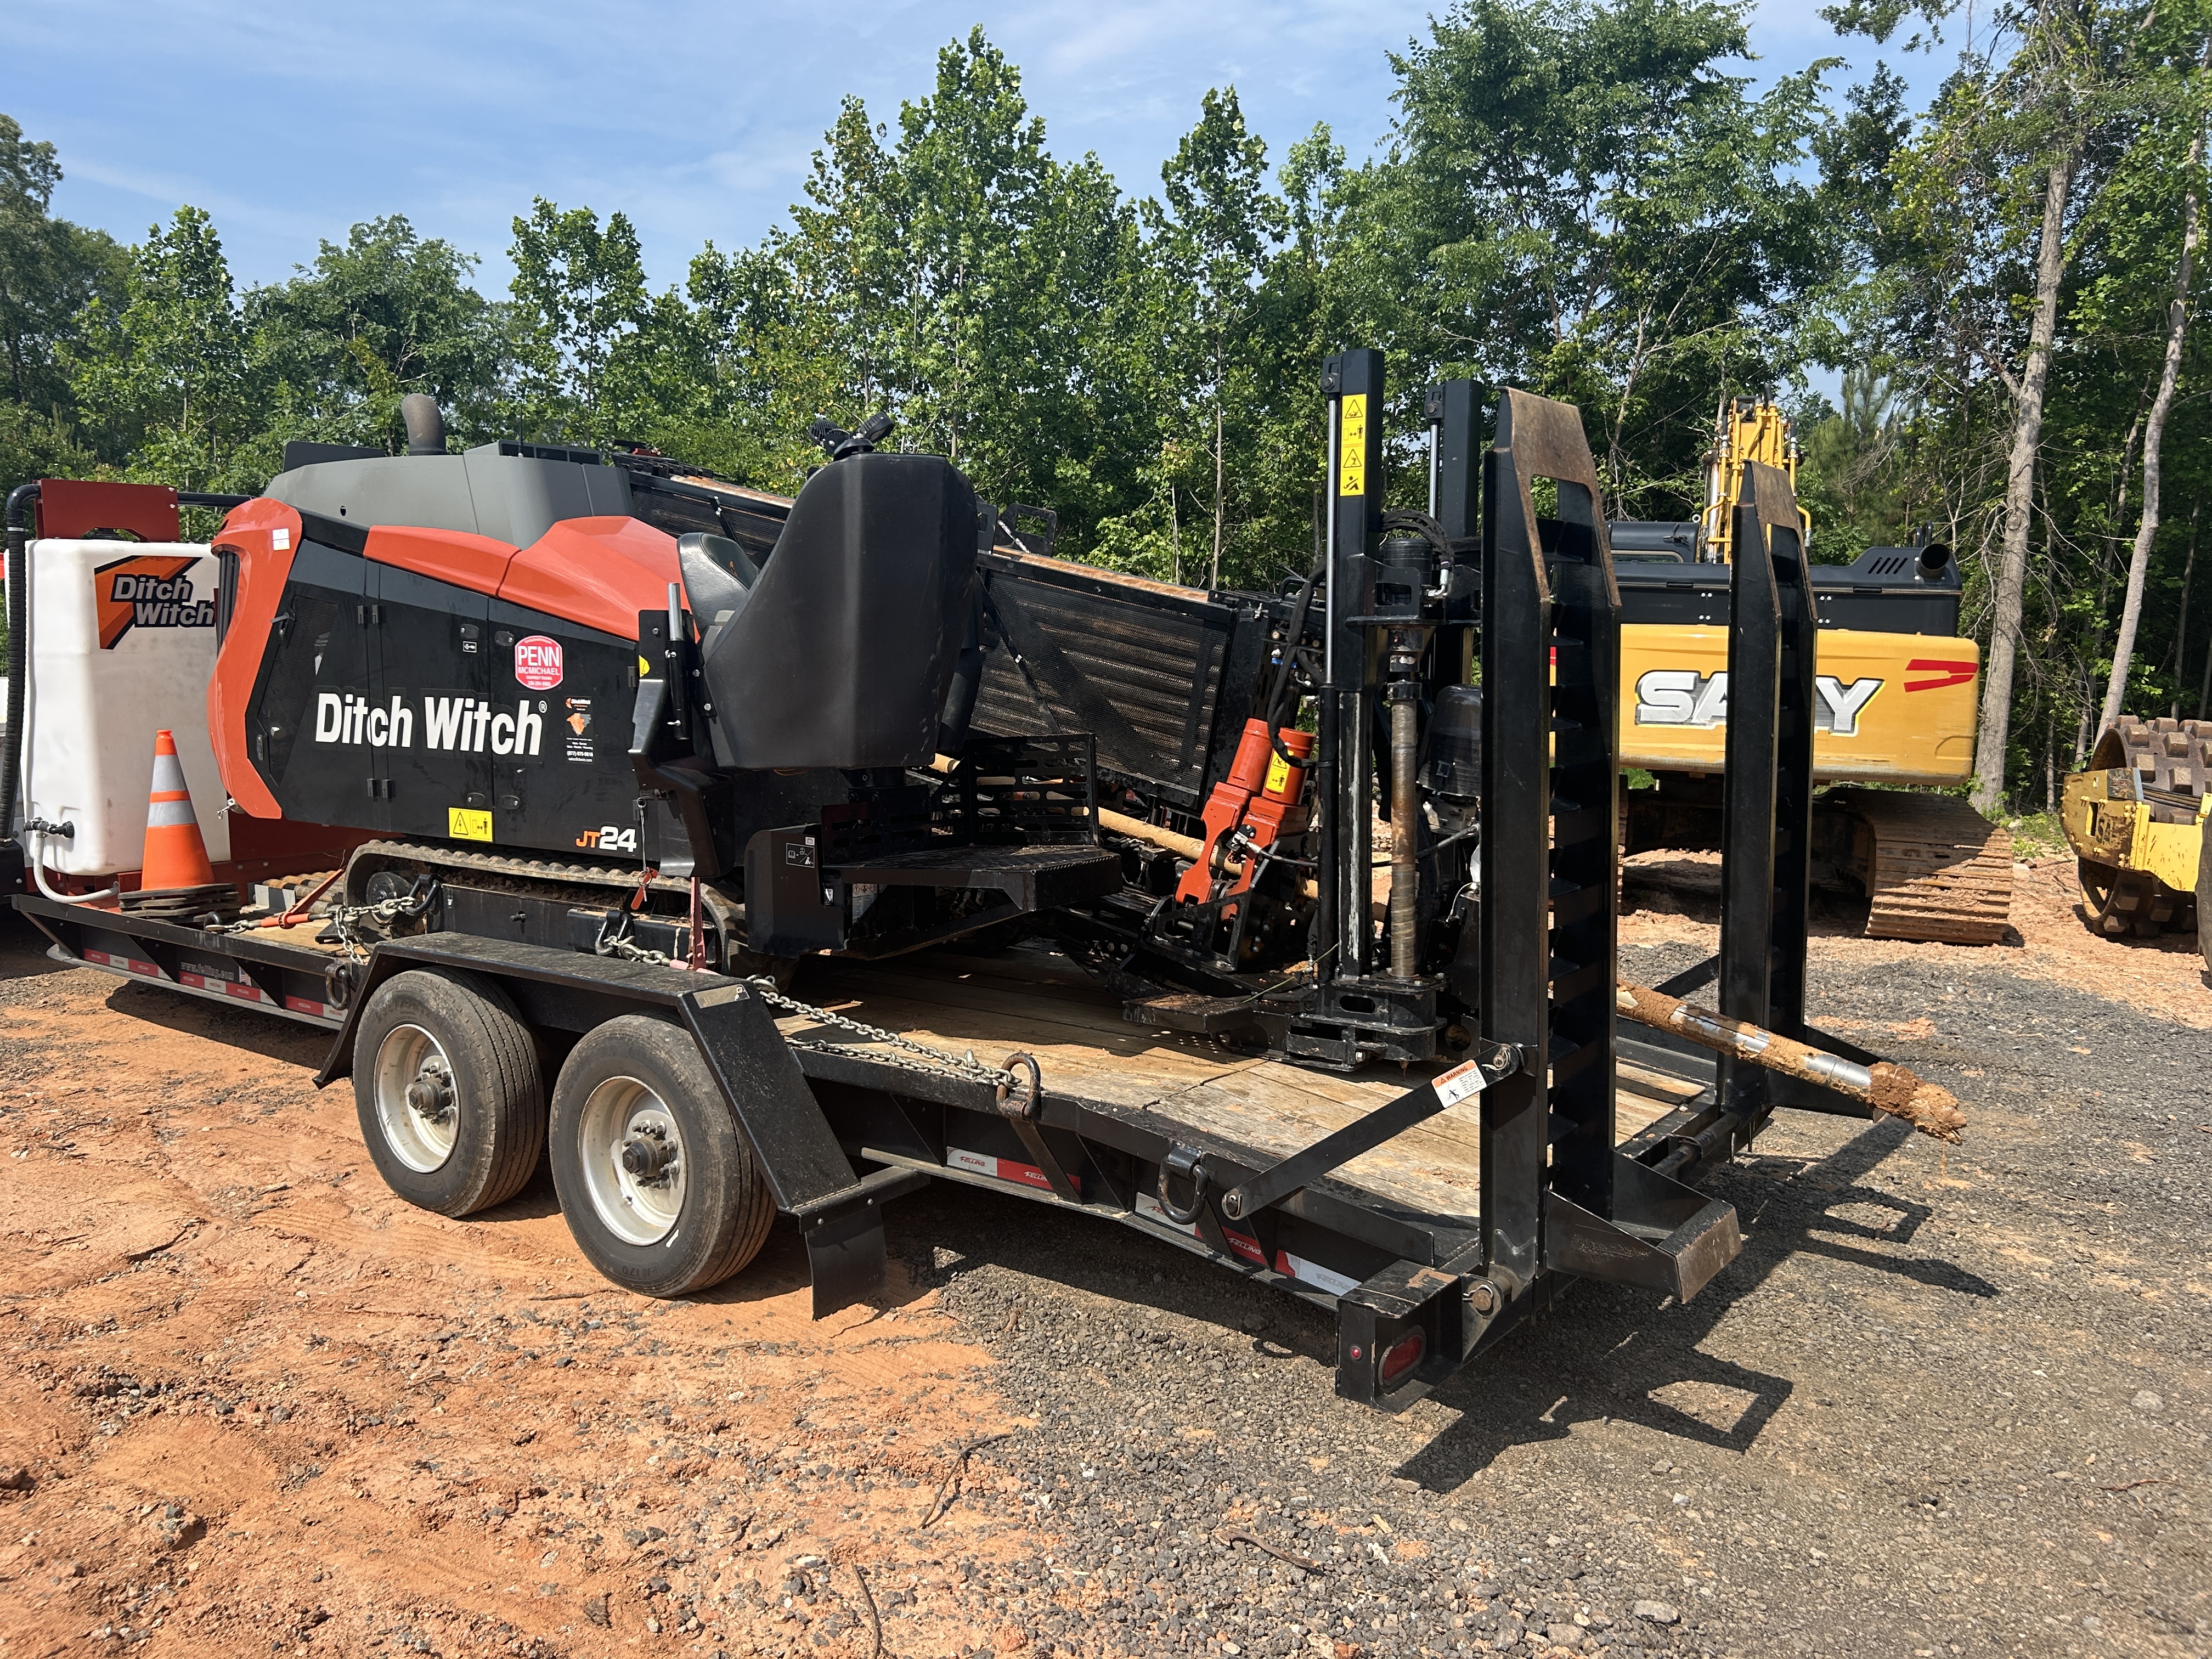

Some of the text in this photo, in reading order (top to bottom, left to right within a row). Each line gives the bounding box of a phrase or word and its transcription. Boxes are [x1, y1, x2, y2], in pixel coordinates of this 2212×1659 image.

[114, 577, 191, 600] Ditch
[136, 602, 215, 625] Witch
[518, 645, 560, 667] PENN
[517, 667, 560, 676] MCMICHAEL
[1639, 670, 1882, 732] SAY
[315, 693, 413, 747] Ditch
[575, 826, 637, 853] JT24
[1446, 1065, 1468, 1081] WARNING
[959, 1155, 986, 1167] FELLING
[1024, 1170, 1048, 1181] FELLIN
[1228, 1237, 1261, 1255] FELLING
